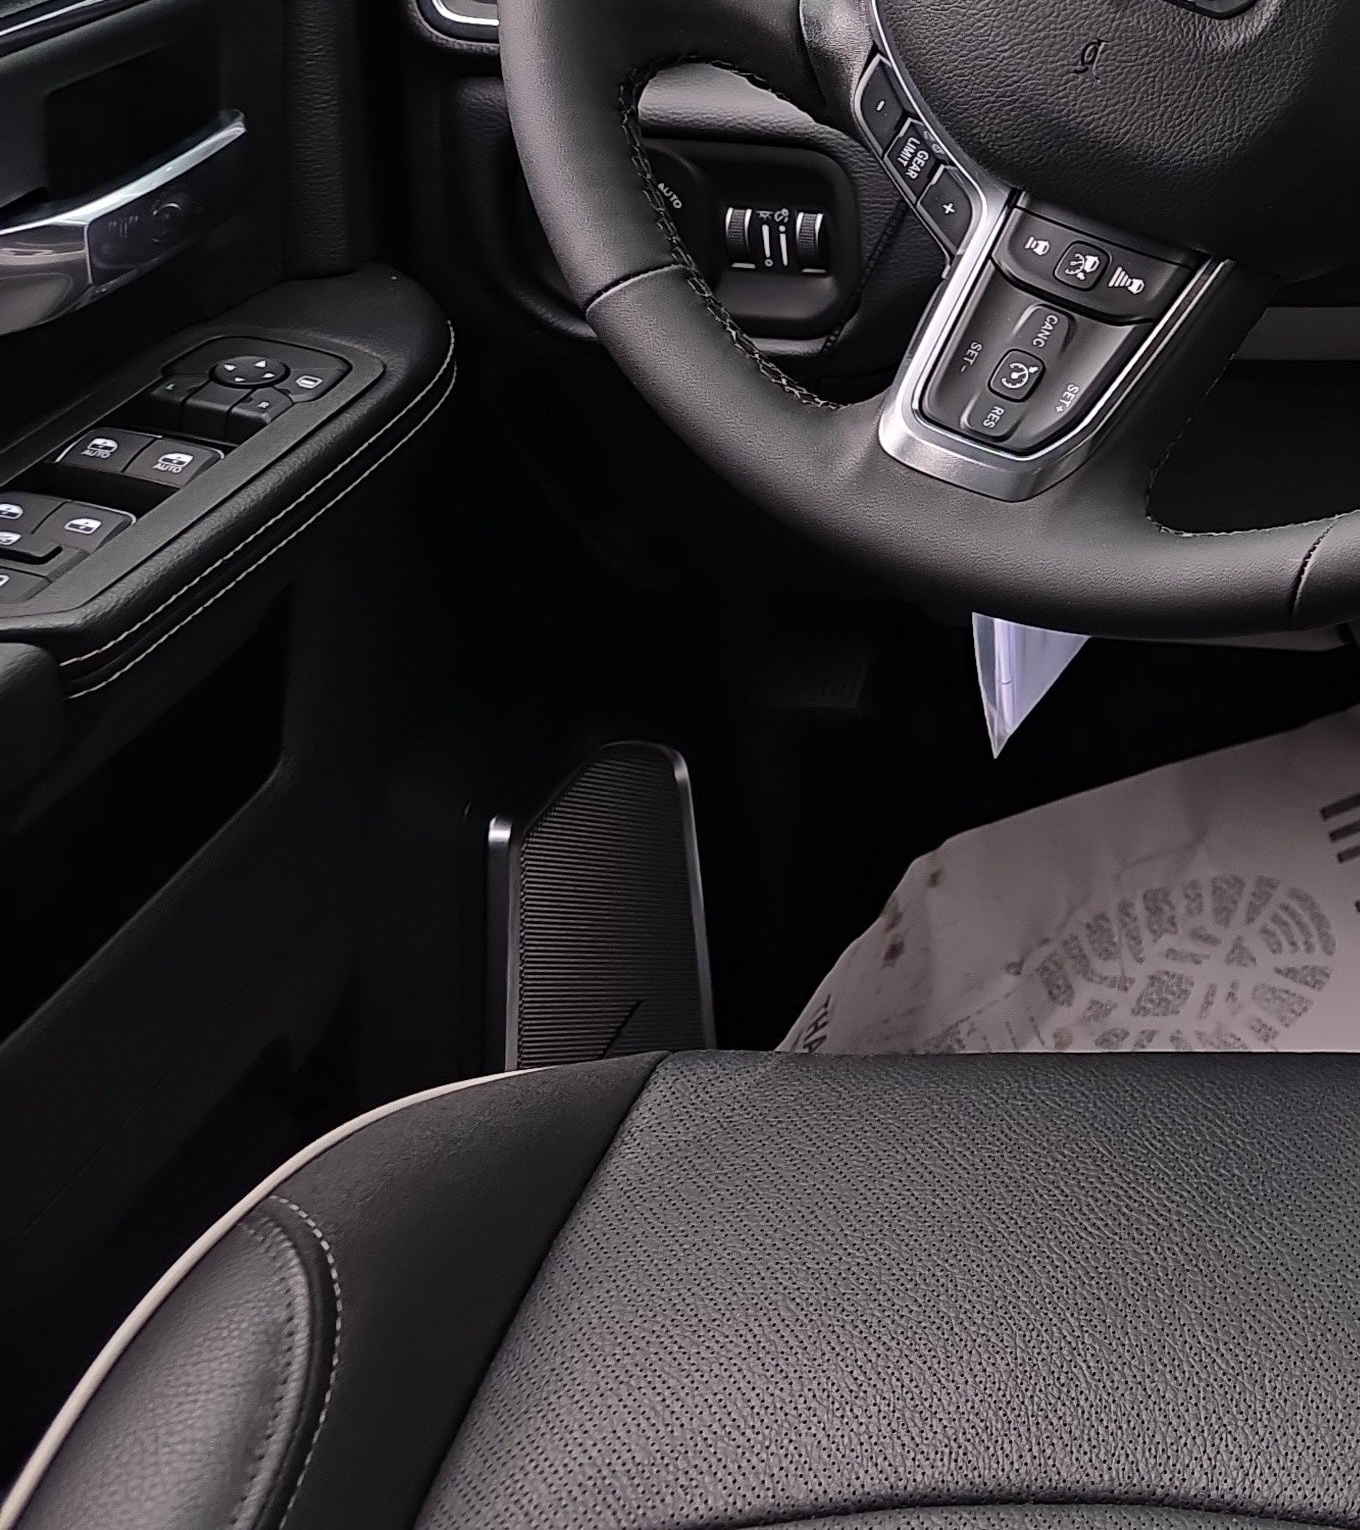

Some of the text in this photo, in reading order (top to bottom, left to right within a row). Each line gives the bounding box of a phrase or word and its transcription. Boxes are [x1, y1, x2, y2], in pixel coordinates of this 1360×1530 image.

[897, 137, 921, 168] LIMIT
[905, 150, 929, 181] GEAR
[657, 182, 683, 209] AUTO
[1032, 314, 1059, 349] CANC
[983, 405, 1005, 429] RES
[81, 449, 111, 459] AUTO
[152, 463, 183, 474] AUTO
